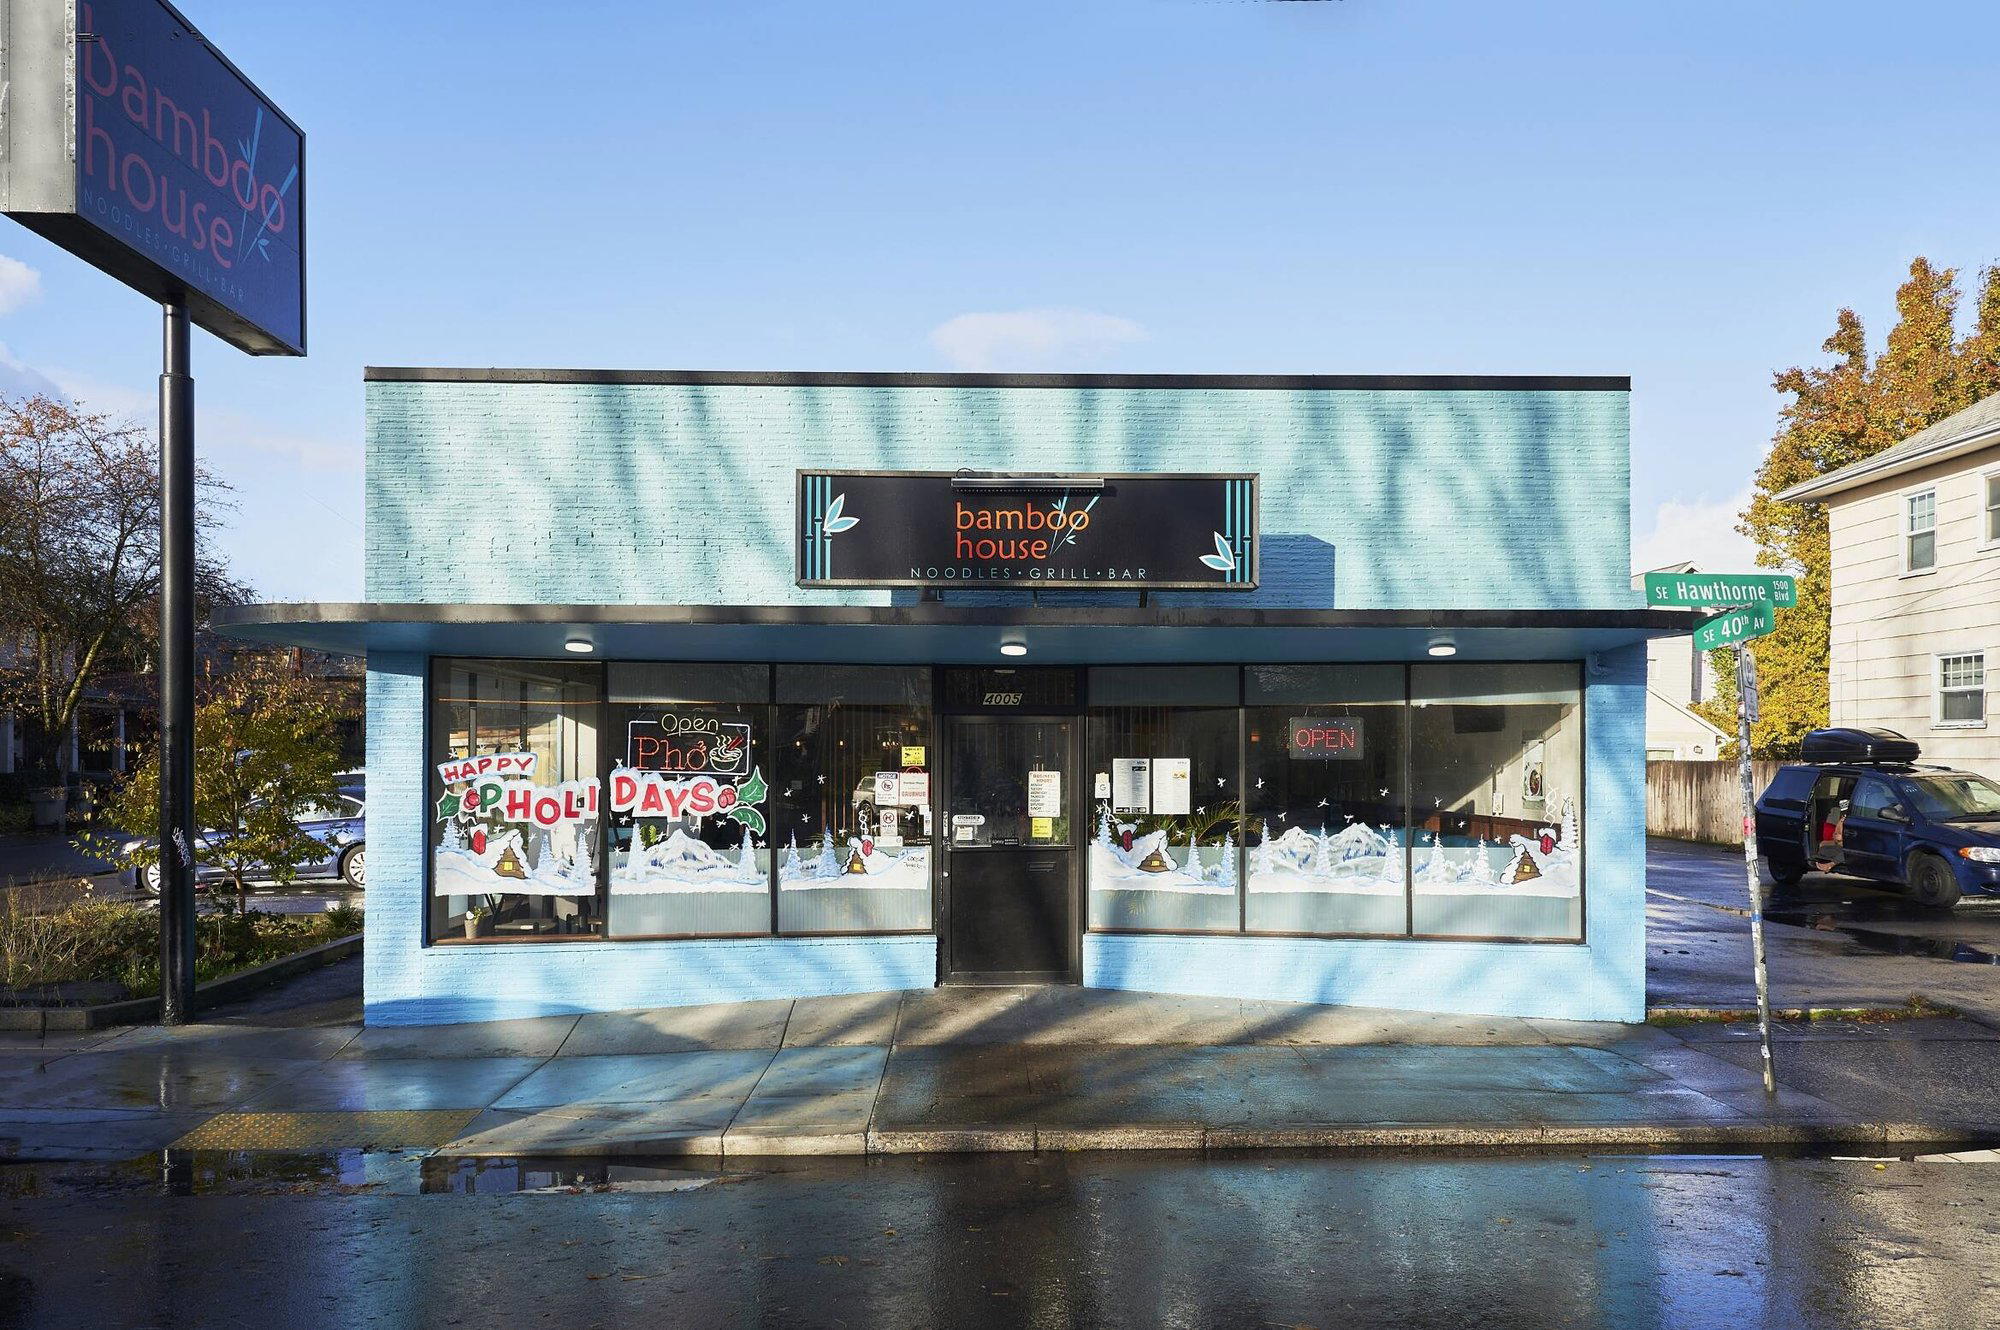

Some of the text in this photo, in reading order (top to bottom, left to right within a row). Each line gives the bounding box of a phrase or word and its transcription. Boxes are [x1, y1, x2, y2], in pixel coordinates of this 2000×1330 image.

[84, 3, 286, 234] bamboo
[85, 93, 233, 269] house
[84, 188, 161, 248] NOODLES
[956, 501, 1091, 531] bamboo
[956, 531, 1048, 560] house
[911, 567, 1147, 579] NOODLES GRILL BAR
[1655, 581, 1790, 601] SE Hawthorne Blvd
[1703, 628, 1716, 643] SE
[984, 694, 1021, 705] 4005
[661, 713, 719, 737] Open
[1295, 729, 1355, 748] OPEN
[444, 757, 533, 782] HAPPY
